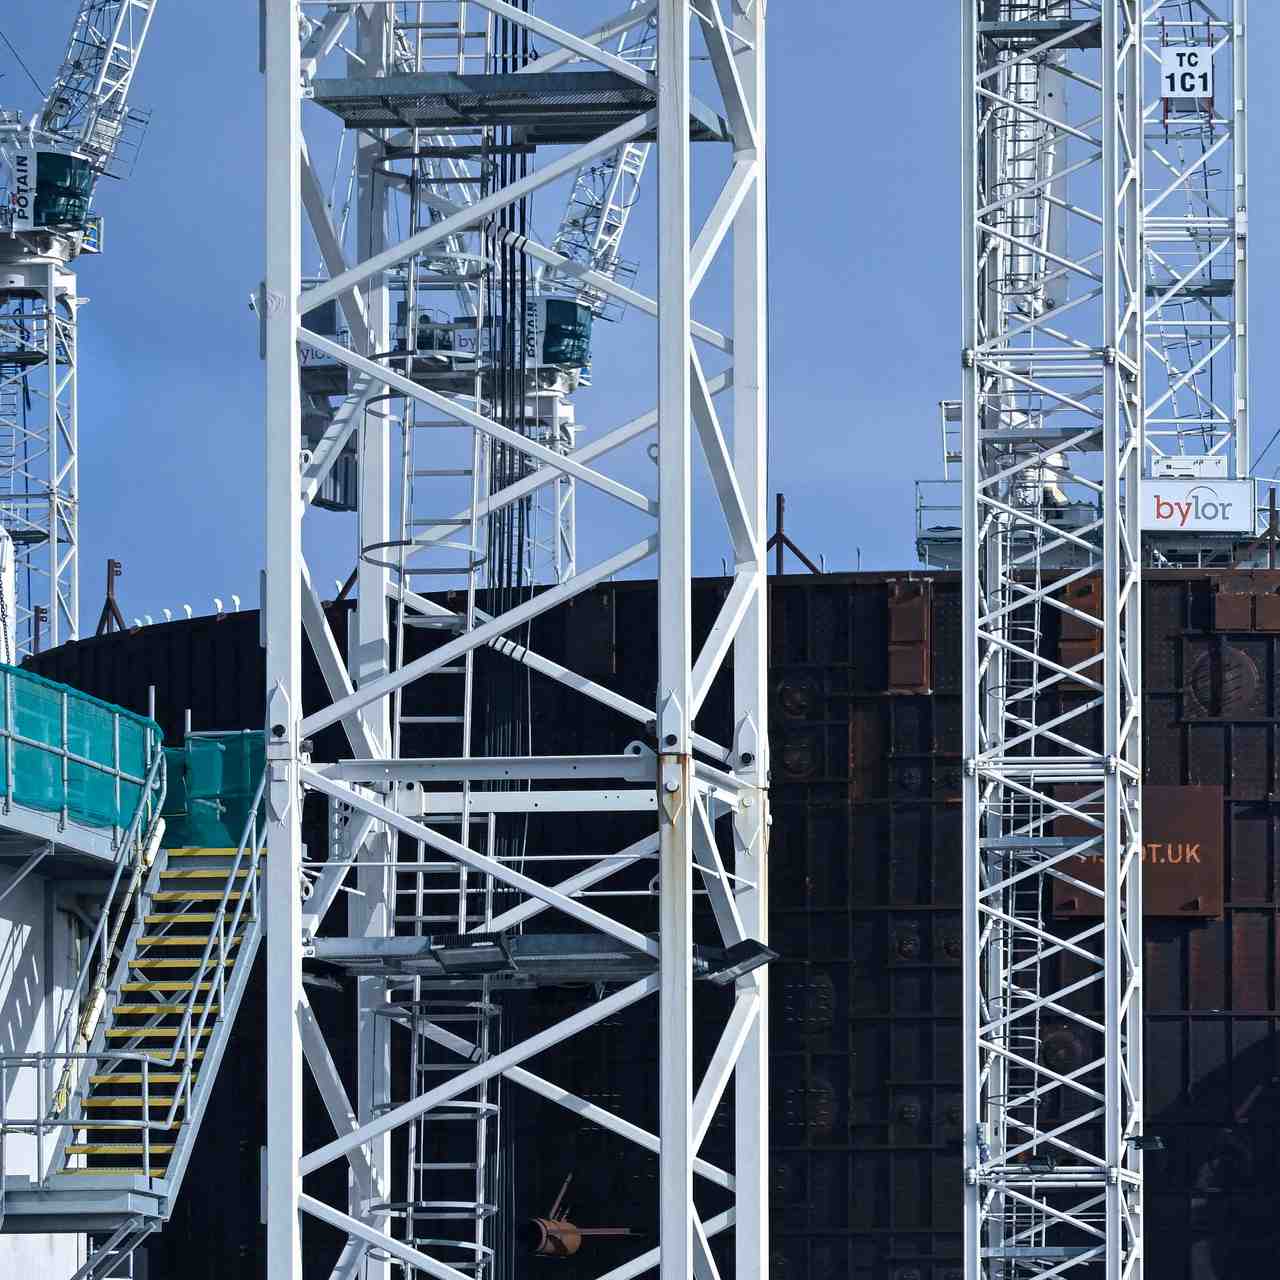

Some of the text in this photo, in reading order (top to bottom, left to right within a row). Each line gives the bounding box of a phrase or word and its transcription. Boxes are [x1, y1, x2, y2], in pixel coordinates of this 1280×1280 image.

[1176, 52, 1198, 67] TC
[1165, 72, 1208, 92] 1C1
[16, 155, 29, 219] POTAIN
[300, 348, 332, 364] ylo
[1153, 495, 1233, 527] bylor
